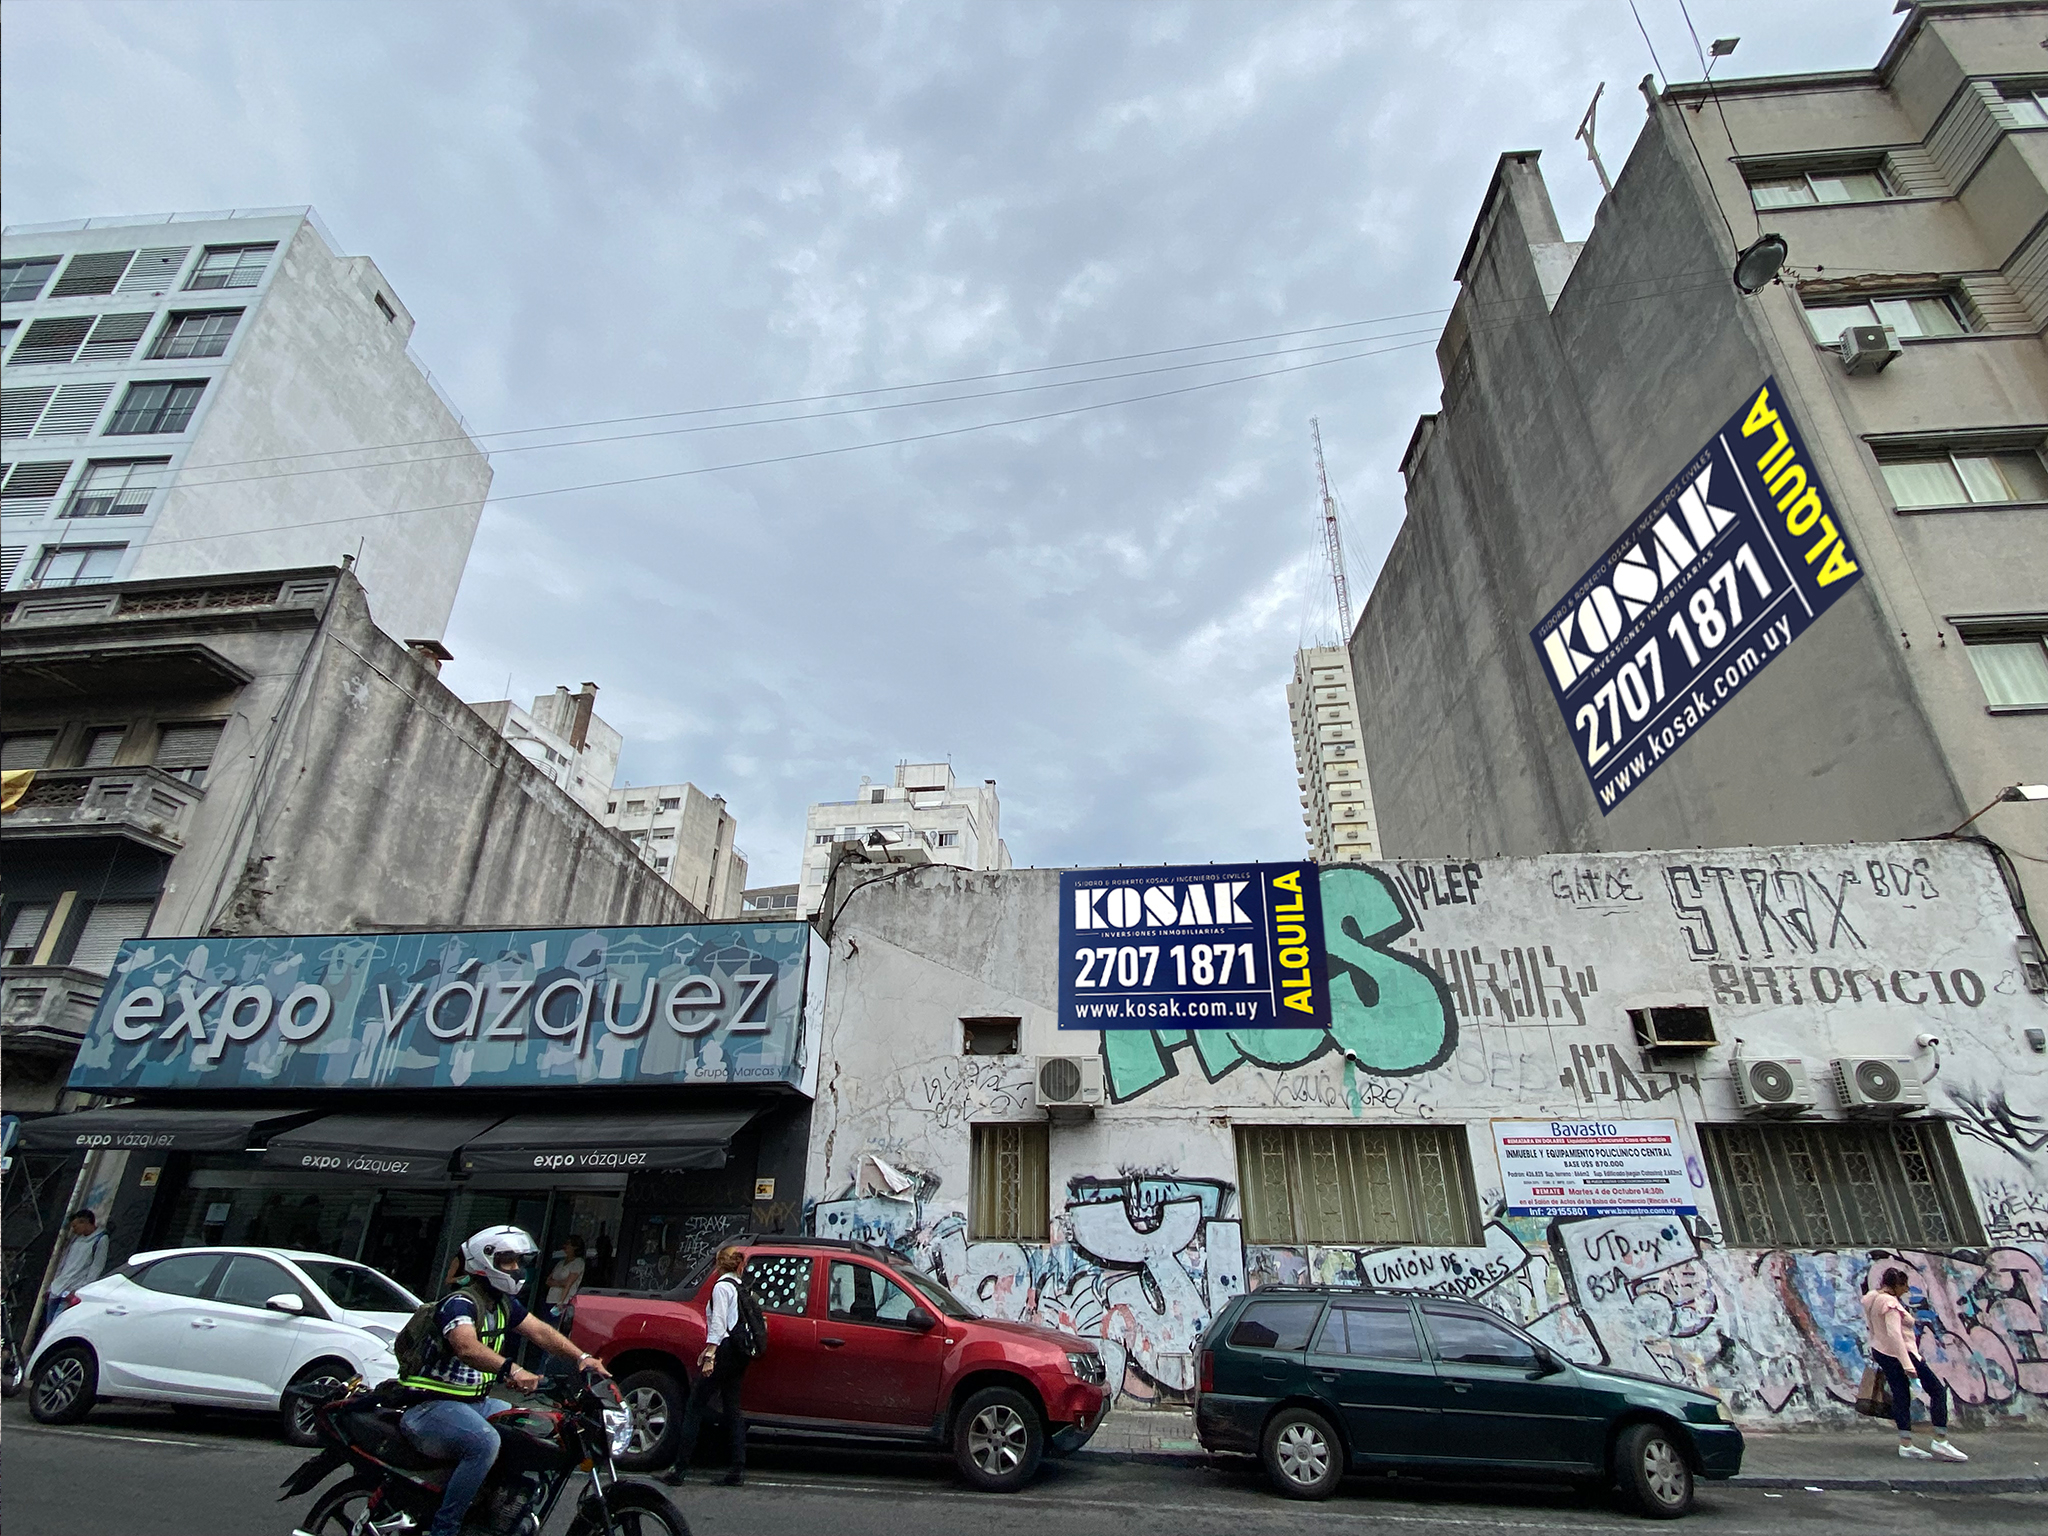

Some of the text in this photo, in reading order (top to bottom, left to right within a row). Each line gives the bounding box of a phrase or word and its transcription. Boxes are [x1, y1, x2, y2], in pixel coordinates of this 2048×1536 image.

[1740, 386, 1860, 589] ALQUILA
[1538, 606, 1567, 637] ISIDORO
[1574, 565, 1606, 603] ROBERTO
[1607, 537, 1632, 566] KOSAK
[1636, 485, 1681, 533] INGENIEROS
[1681, 449, 1711, 485] CIVILES
[1542, 460, 1737, 693] KOSAK
[1590, 551, 1714, 679] INVERSIONES INMOBILIARIAS
[1575, 541, 1773, 768] 2707 1871
[1599, 613, 1793, 807] www.kosak.com.uy
[1112, 878, 1144, 886] ROBERTO
[1176, 874, 1220, 883] INGENIEROS
[1222, 872, 1251, 880] CIVILES
[1074, 881, 1254, 930] KOSAK
[1101, 927, 1226, 938] INVERSIONES INMOBILIARIAS
[1272, 869, 1315, 1015] ALQUILA
[1075, 942, 1256, 988] 2707 1871
[111, 981, 333, 1059] expo
[377, 957, 773, 1056] vázquez
[1075, 998, 1258, 1021] www.kosak.com.uy
[694, 1066, 729, 1079] Grupo
[733, 1066, 775, 1078] Marcas
[75, 1131, 176, 1149] expo vázquez
[1551, 1121, 1617, 1137] Bavastro
[301, 1153, 410, 1175] expo vázquez
[533, 1150, 647, 1171] expo vázquez
[1505, 1149, 1537, 1158] INMUEBLE
[1538, 1149, 1545, 1158] Y
[1546, 1149, 1595, 1158] EQUIPAMIENTO
[1640, 1148, 1672, 1157] CENTRAL
[1612, 1187, 1641, 1195] Octubre
[1529, 1207, 1676, 1216] Inf: 29155801 www.bavastro.com.uy
